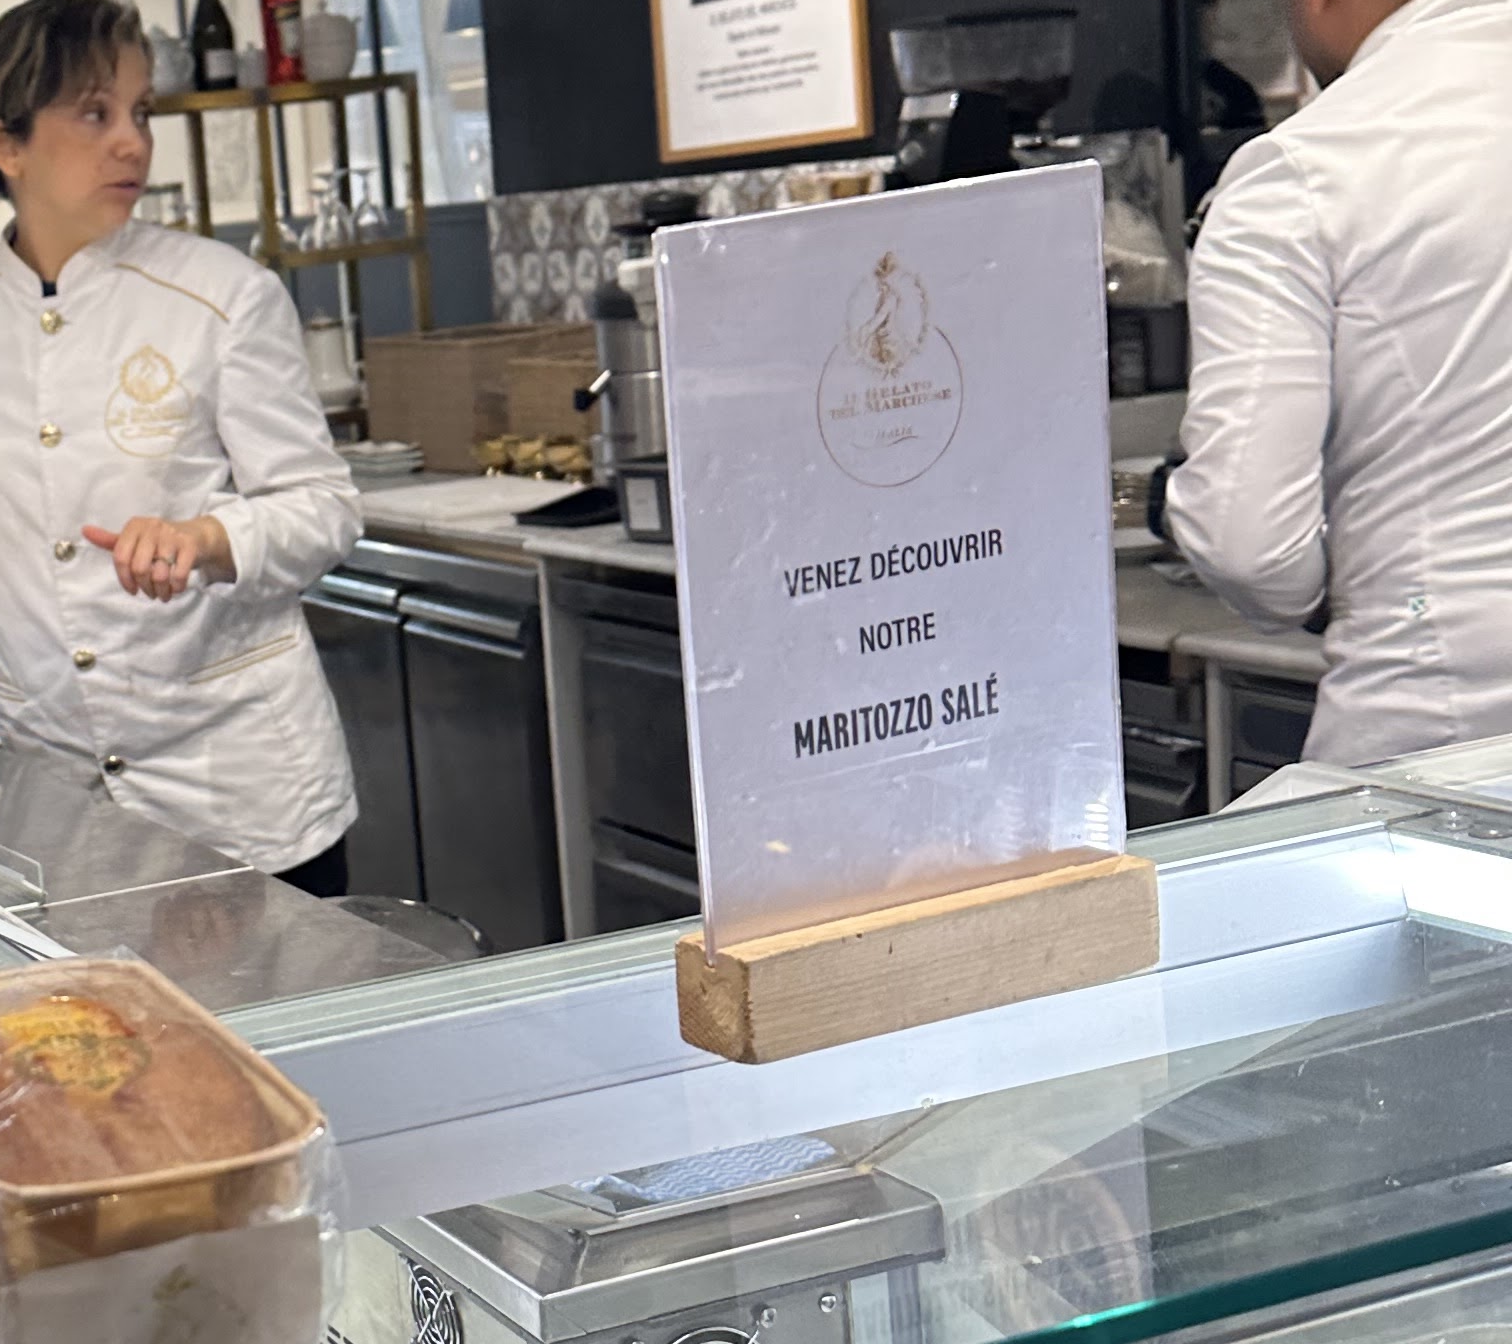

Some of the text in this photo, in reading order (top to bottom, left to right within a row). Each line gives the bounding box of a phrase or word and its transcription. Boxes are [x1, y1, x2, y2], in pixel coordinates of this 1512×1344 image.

[784, 528, 1004, 598] VENEZ DÉCOUVRIR
[859, 611, 937, 655] NOTRE
[793, 671, 1000, 759] MARITOZZO SALÉ
